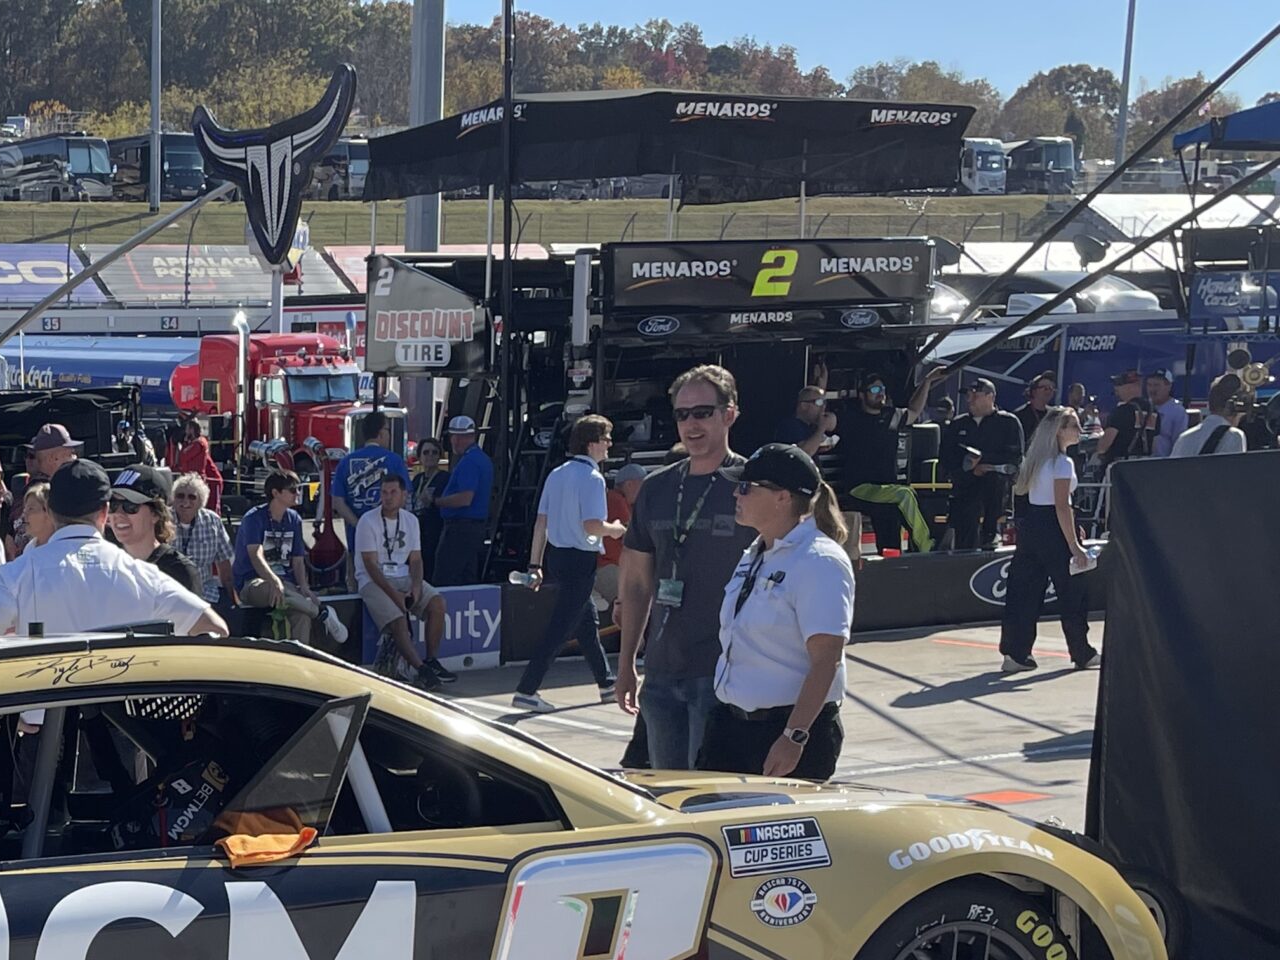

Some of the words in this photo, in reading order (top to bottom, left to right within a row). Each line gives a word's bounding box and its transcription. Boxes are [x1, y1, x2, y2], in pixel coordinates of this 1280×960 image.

[461, 103, 523, 127] MENARS
[675, 102, 771, 118] MENARDS
[870, 109, 952, 125] MENARDS
[152, 256, 258, 268] APPALACH
[156, 267, 234, 278] POWER
[631, 260, 731, 278] MENARDS
[751, 250, 799, 297] 2
[820, 256, 913, 274] MENARDS
[374, 267, 395, 297] 2
[44, 318, 60, 330] 35
[162, 317, 178, 329] 34
[375, 308, 476, 342] DISCOUNT
[730, 311, 793, 325] MENARDS
[1068, 335, 1116, 351] NASCAR
[401, 344, 443, 361] TIRE
[167, 782, 215, 841] BETMGM
[755, 822, 806, 841] NASCAR
[744, 848, 769, 864] CUP
[770, 842, 813, 861] SERIES
[888, 828, 1056, 870] GOODYEAR
